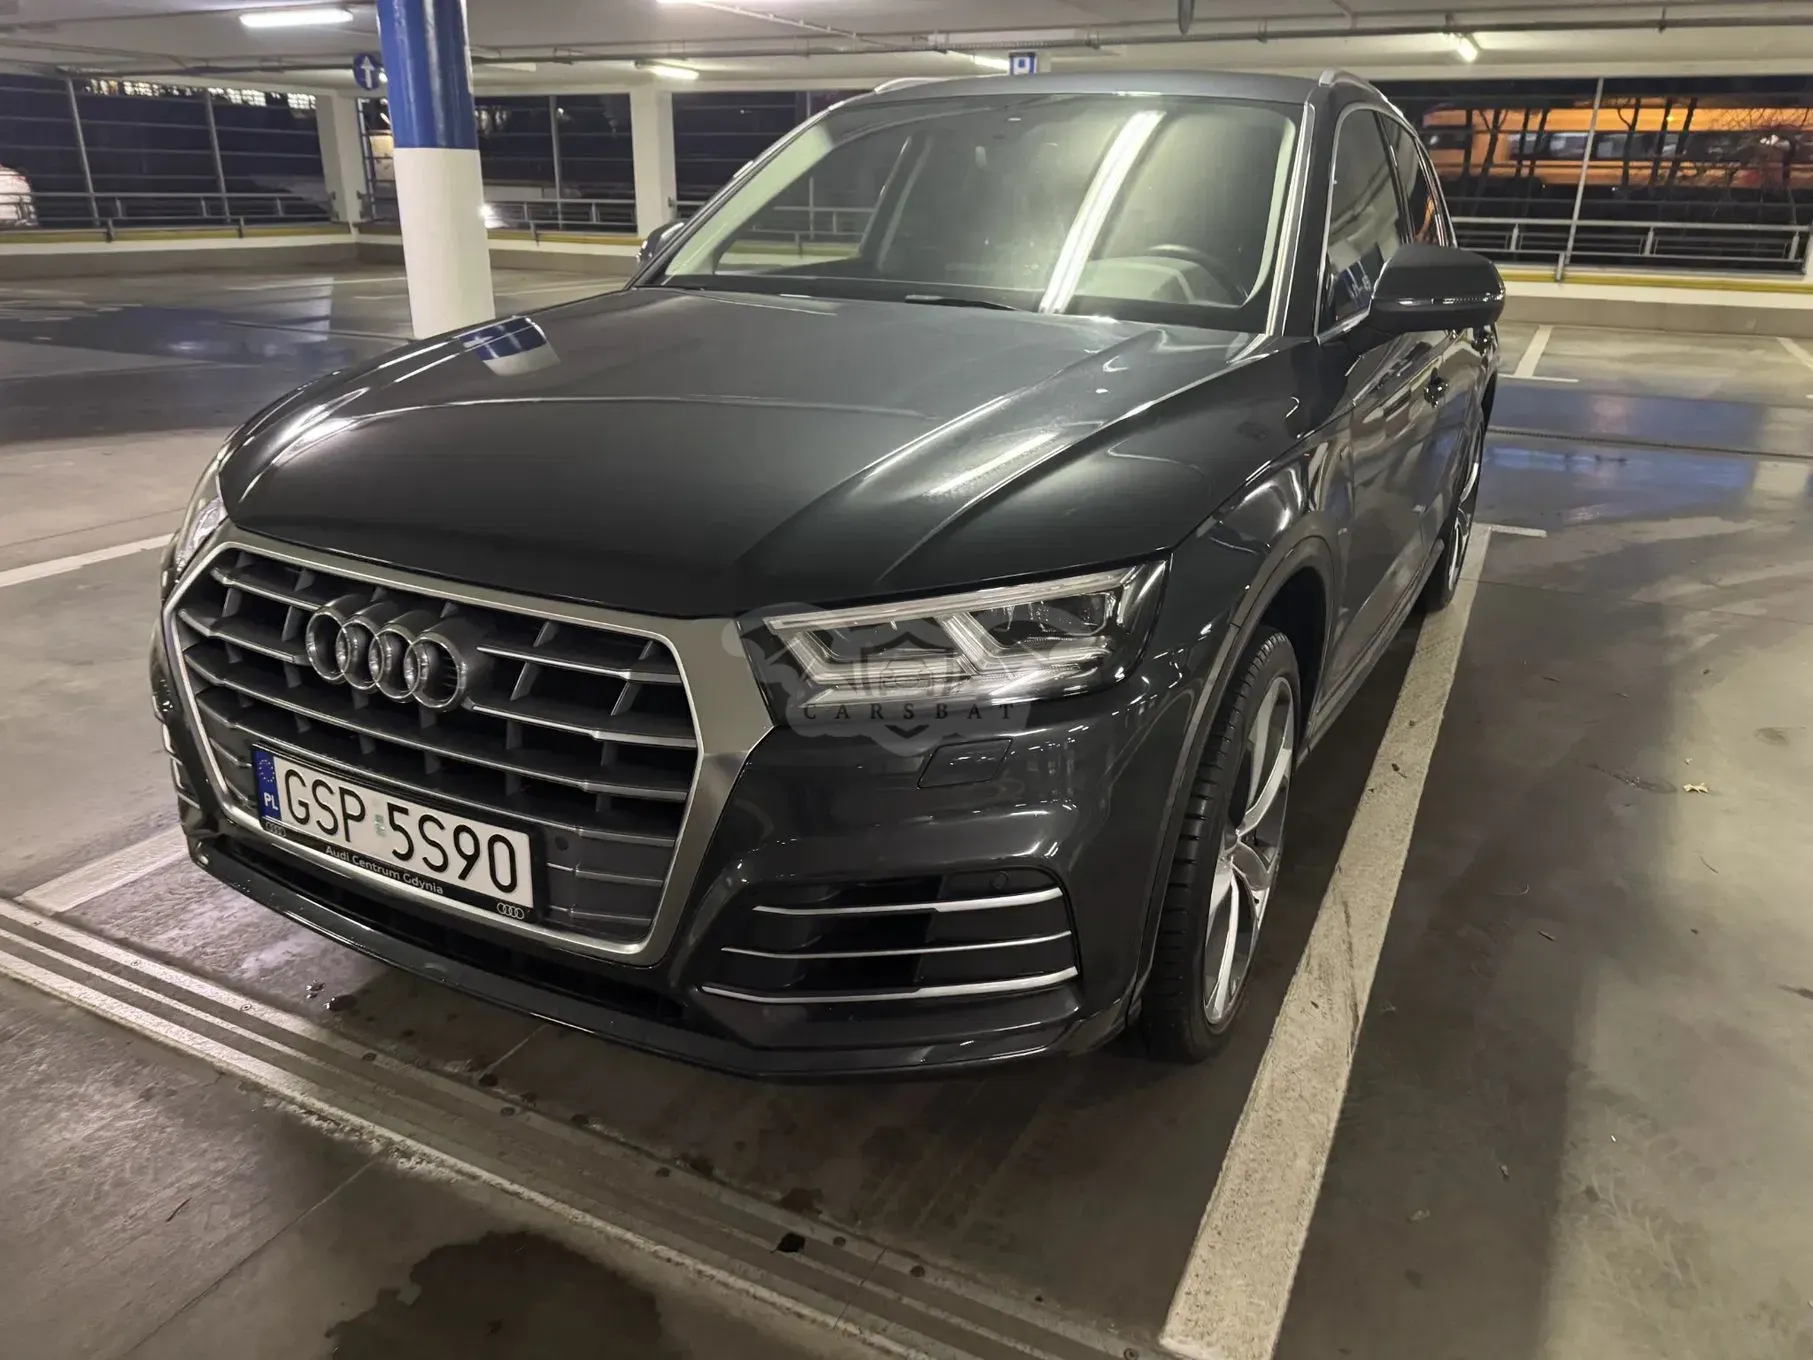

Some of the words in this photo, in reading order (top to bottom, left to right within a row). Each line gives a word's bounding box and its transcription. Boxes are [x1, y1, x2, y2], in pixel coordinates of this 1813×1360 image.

[264, 793, 279, 810] PL
[284, 769, 366, 842] GSP
[387, 801, 518, 894] 5S90
[325, 845, 350, 863] Audi
[352, 855, 400, 881] Centrum
[402, 873, 444, 895] Gdynia
